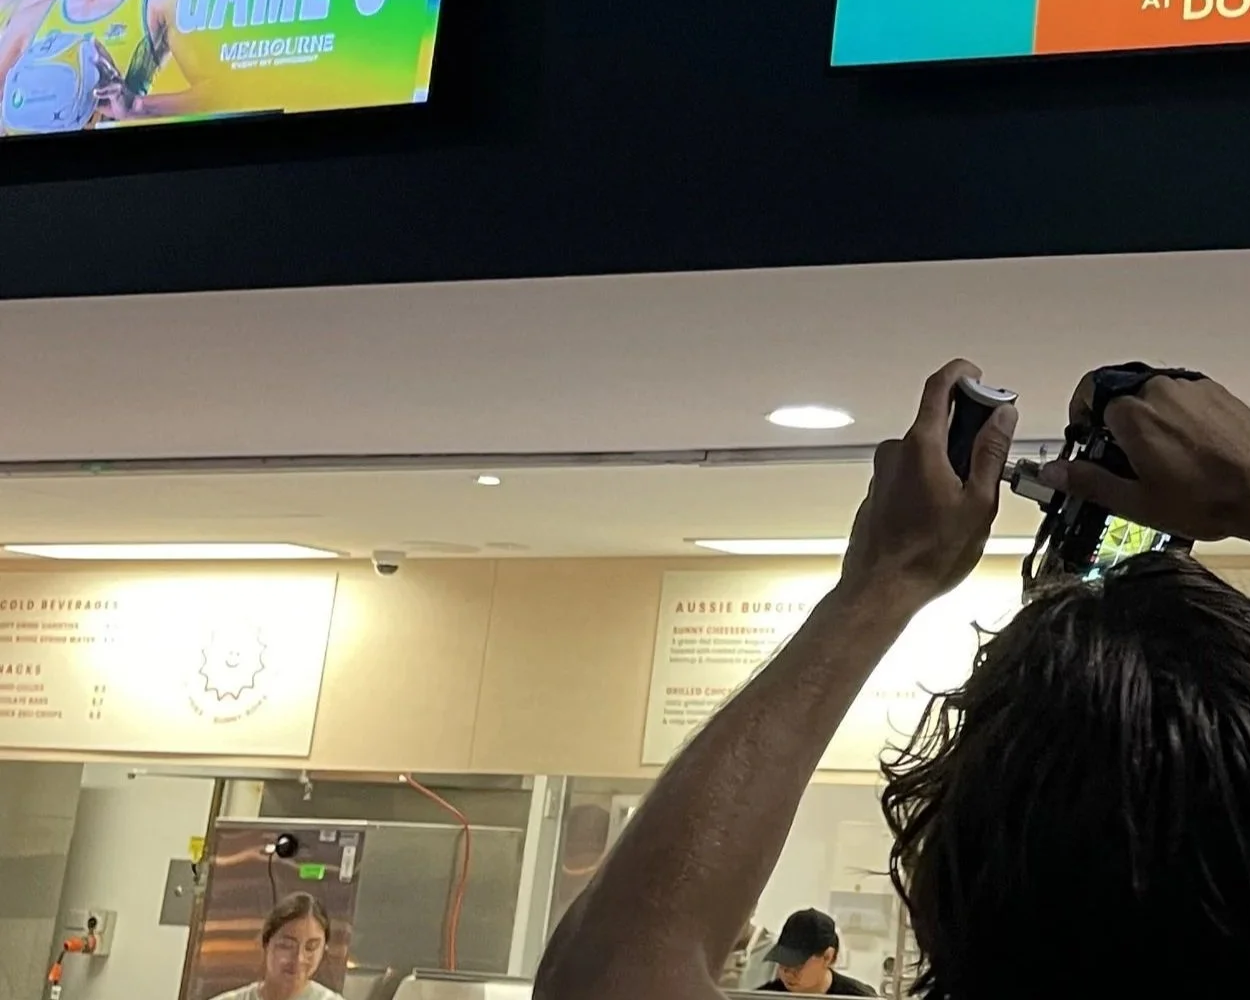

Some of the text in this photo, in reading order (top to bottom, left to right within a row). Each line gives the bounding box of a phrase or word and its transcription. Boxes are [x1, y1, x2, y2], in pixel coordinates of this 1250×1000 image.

[219, 32, 336, 62] MELBOURNE
[0, 599, 119, 612] COLD BEVERAGES
[675, 601, 733, 614] AUSSIE
